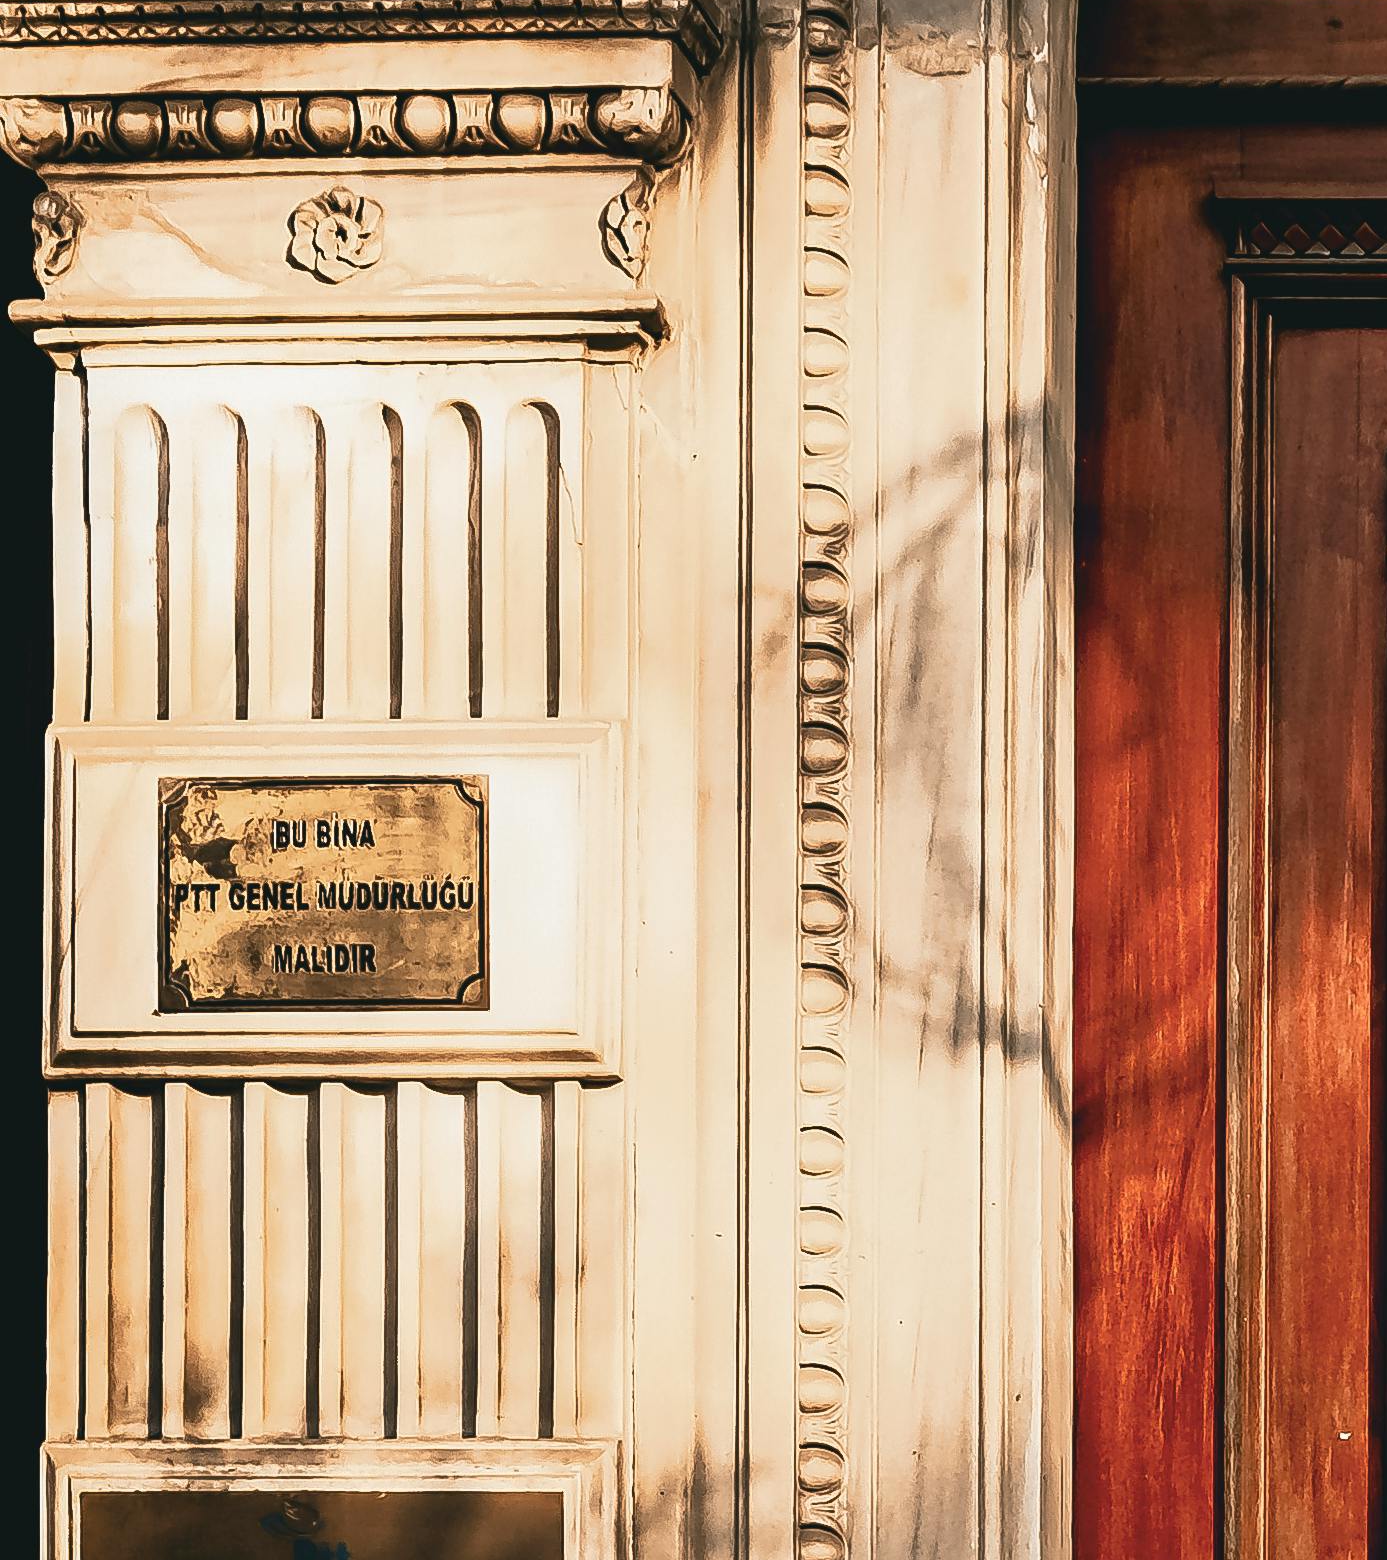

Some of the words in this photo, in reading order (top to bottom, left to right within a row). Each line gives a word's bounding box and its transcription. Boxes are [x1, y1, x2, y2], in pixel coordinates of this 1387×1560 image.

[273, 820, 307, 849] BU
[315, 813, 376, 849] BİNA
[174, 882, 221, 912] PTT
[228, 881, 310, 911] GENEL
[273, 943, 377, 974] MALIDIR
